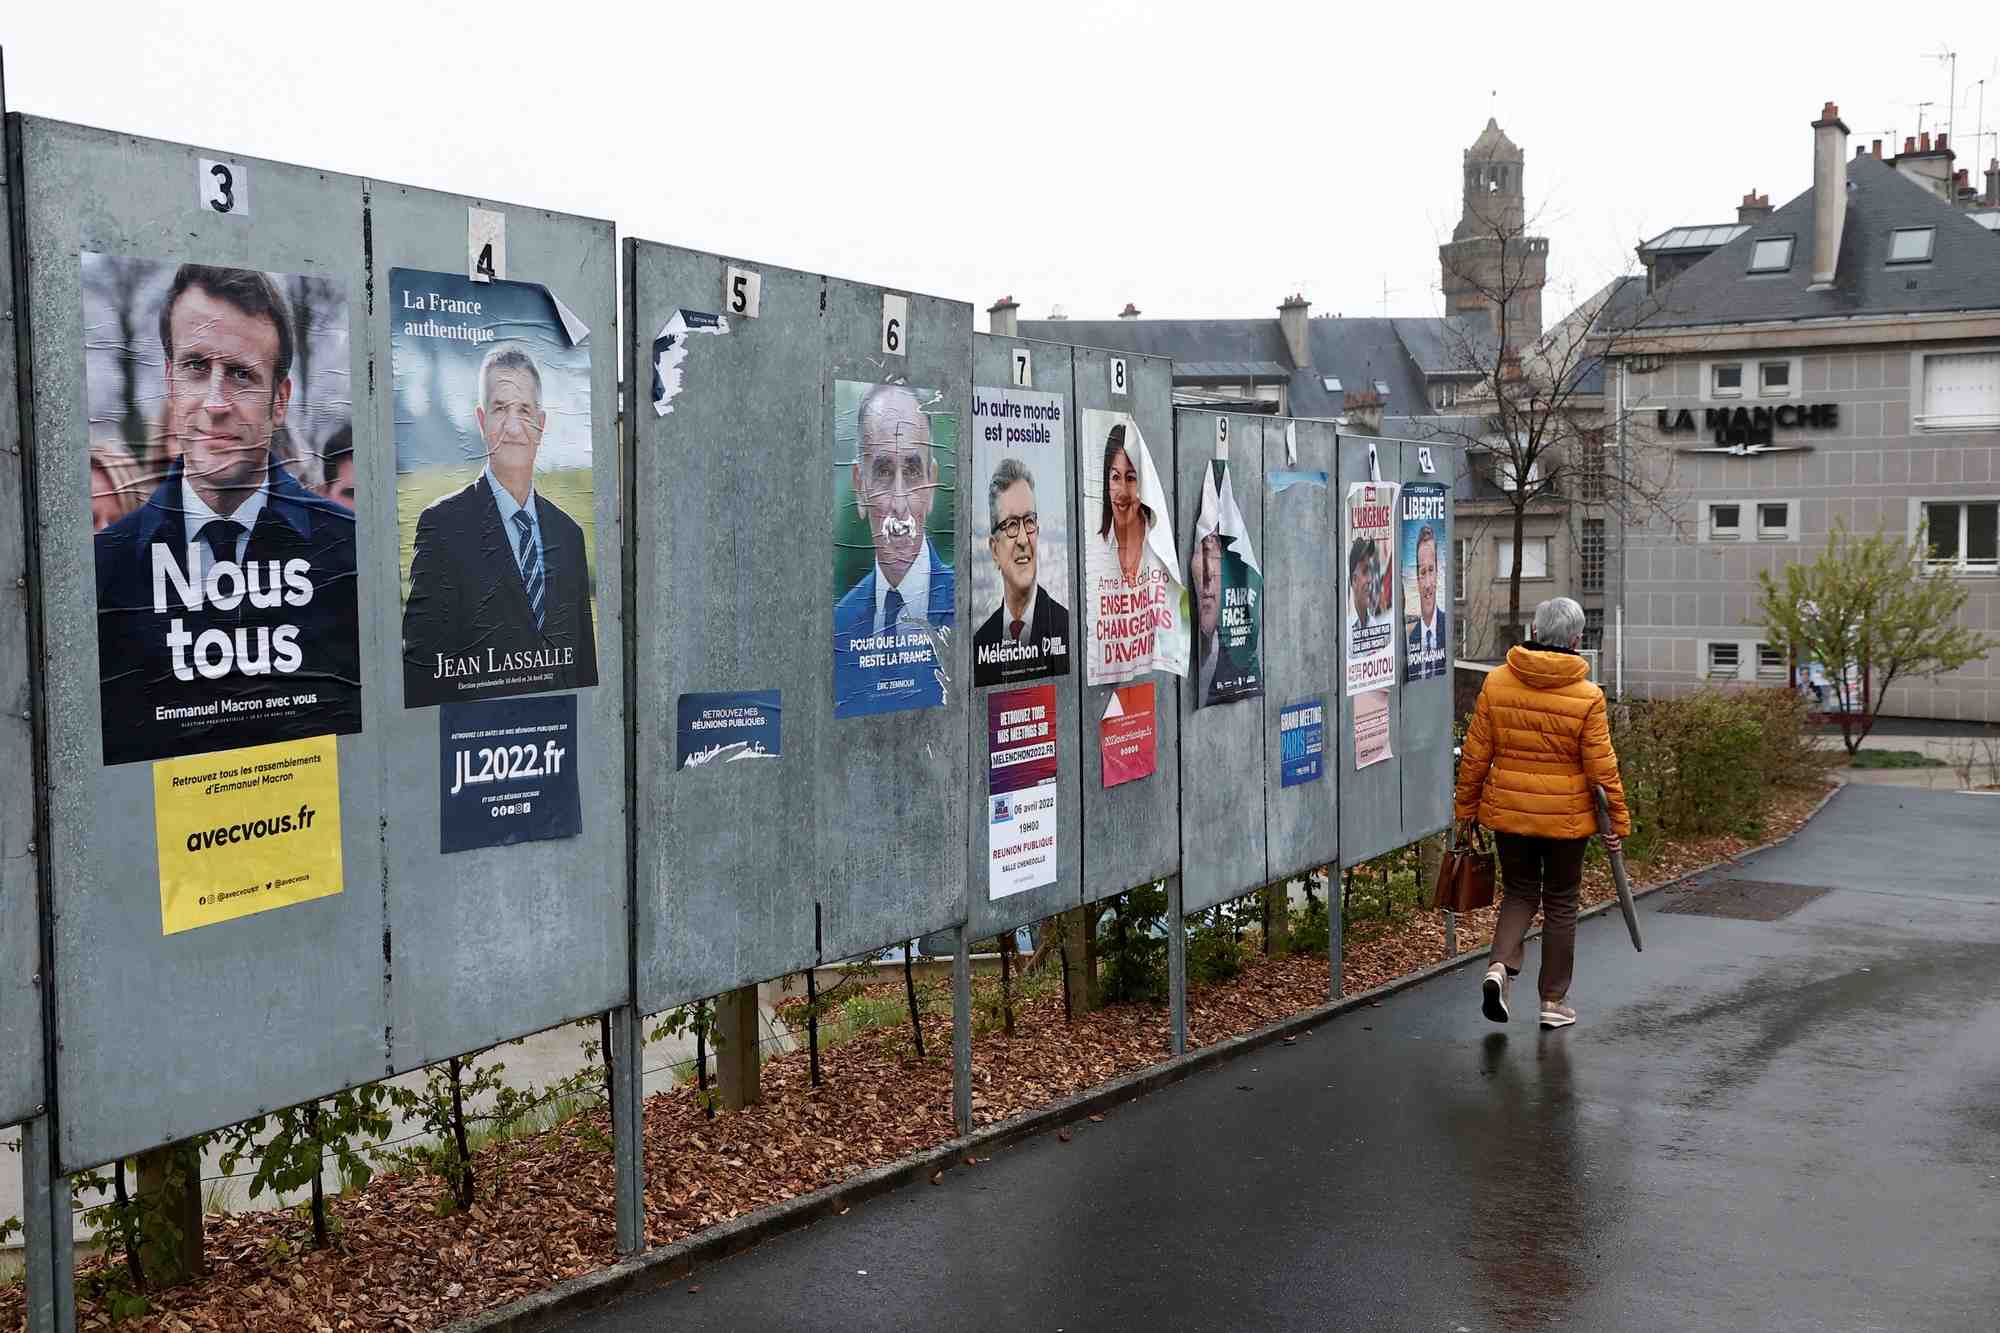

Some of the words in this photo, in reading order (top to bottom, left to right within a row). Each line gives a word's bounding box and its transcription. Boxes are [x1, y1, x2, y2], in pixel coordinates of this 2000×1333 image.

[211, 164, 234, 213] 3
[477, 243, 496, 282] 4
[403, 290, 425, 310] La
[429, 293, 482, 315] France
[732, 276, 747, 312] 5
[404, 318, 495, 345] authentique
[887, 318, 900, 351] 6
[1017, 356, 1026, 384] 7
[1116, 361, 1124, 388] 8
[972, 395, 988, 416] Un
[990, 399, 1021, 418] autre
[1023, 400, 1060, 420] monde
[1658, 409, 1695, 432] LA
[1705, 404, 1839, 430] MANCHE
[984, 423, 1002, 441] est
[1006, 423, 1050, 448] possible
[1220, 418, 1227, 441] 9
[1403, 492, 1445, 520] LIBERTÉ
[151, 542, 314, 613] Nous
[1225, 588, 1257, 607] FAIRE
[1096, 608, 1172, 640] CHANGEONS
[1222, 607, 1246, 628] FACE
[166, 618, 303, 681] tous
[850, 638, 875, 652] POUR
[876, 636, 895, 649] QUE
[895, 636, 907, 647] LA
[908, 633, 931, 646] FRAN
[978, 640, 1038, 665] Mélenchon
[1105, 634, 1155, 664] D'AVENIR
[433, 652, 481, 679] JEAN
[487, 647, 574, 673] LASSALLE
[859, 654, 885, 668] RESTE
[886, 654, 898, 666] LA
[899, 650, 932, 664] FRANCE
[1362, 655, 1393, 679] POUTOU
[156, 701, 218, 720] Emmanuel
[221, 699, 262, 713] Macron
[265, 696, 290, 708] avec
[292, 694, 317, 705] vous
[703, 708, 743, 719] RETROUVEZ
[744, 707, 758, 716] MES
[992, 743, 1055, 767] MELENCHON2022.FR
[1280, 728, 1305, 761] PARIS
[172, 770, 217, 787] Retrouvez
[219, 769, 239, 780] tous
[240, 766, 253, 776] les
[254, 754, 321, 773] rassemblements
[450, 740, 566, 794] JL2022.fr
[205, 776, 260, 795] d'Emmanuel
[262, 772, 294, 785] Macron
[1014, 803, 1022, 815] 06
[1024, 800, 1038, 813] avril
[1039, 797, 1054, 810] 2022
[187, 804, 316, 852] avecvous.fr
[992, 843, 1022, 860] REUNION
[1023, 836, 1054, 854] PUBLIQUE
